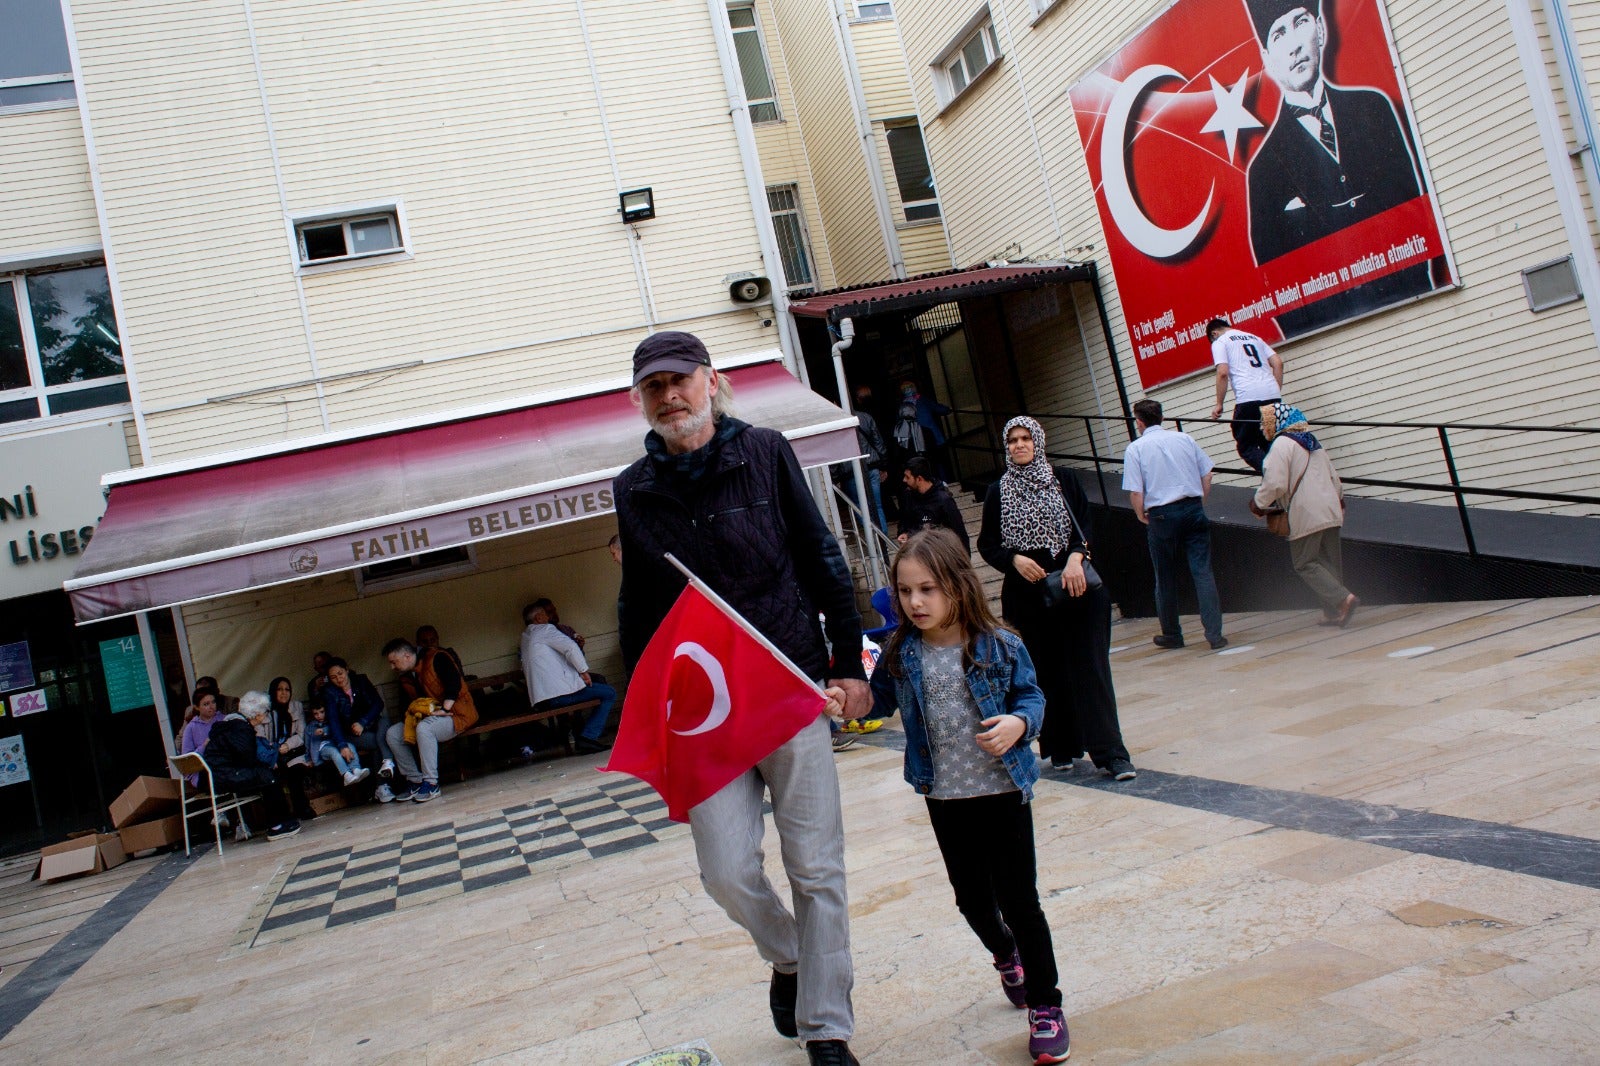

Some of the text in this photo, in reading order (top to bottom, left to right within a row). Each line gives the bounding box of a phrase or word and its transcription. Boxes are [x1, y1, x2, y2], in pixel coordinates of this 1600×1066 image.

[1175, 328, 1190, 346] Türk
[1301, 272, 1339, 297] muhafaza
[1339, 266, 1350, 282] ve
[1350, 252, 1387, 279] müdafaa
[1387, 234, 1428, 264] etmektir.
[1133, 325, 1141, 341] Ey
[1140, 319, 1154, 337] Türk
[1242, 343, 1263, 368] 9
[9, 517, 102, 566] LİSES
[350, 526, 430, 562] FATİH
[117, 637, 136, 653] 14
